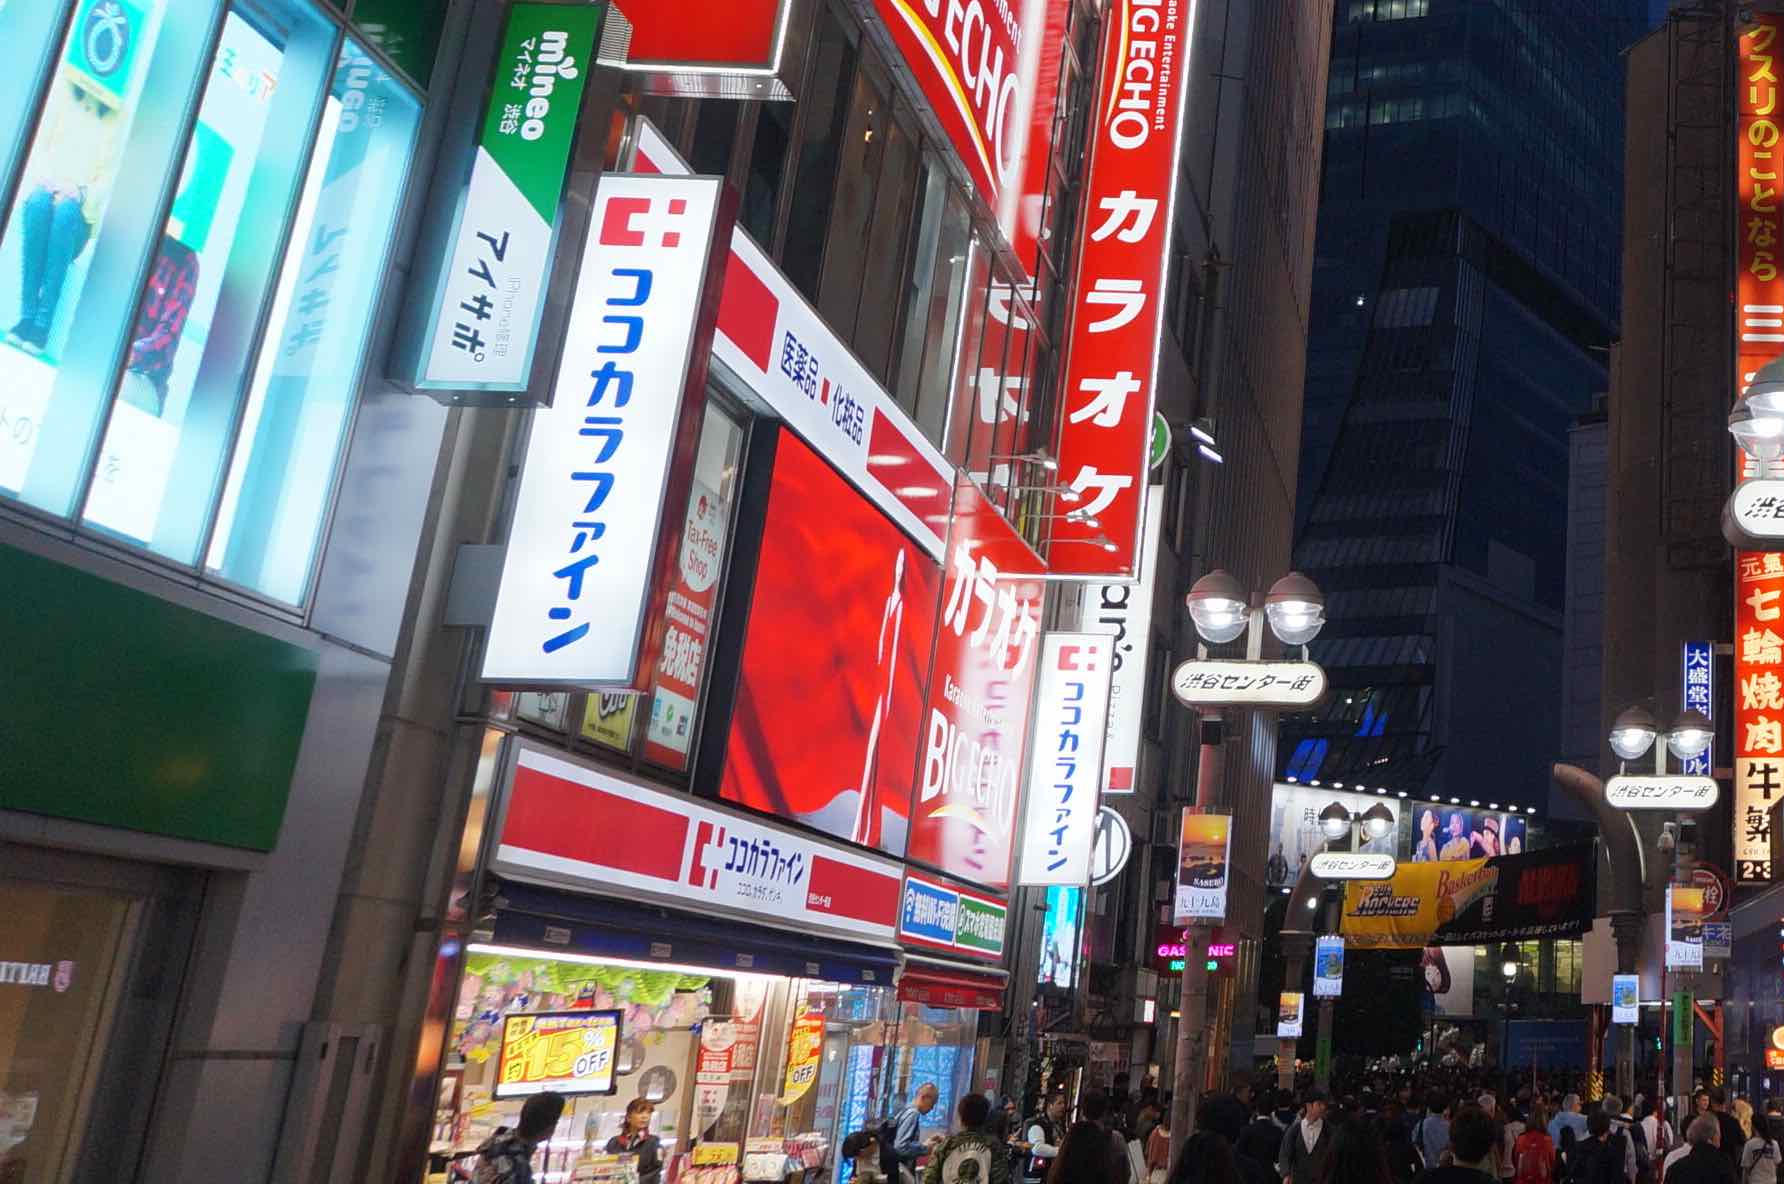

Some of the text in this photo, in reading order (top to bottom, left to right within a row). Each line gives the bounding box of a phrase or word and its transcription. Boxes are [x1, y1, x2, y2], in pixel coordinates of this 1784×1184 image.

[510, 36, 537, 91] マイネオ
[521, 31, 579, 141] mineo
[1110, 41, 1156, 150] ECHO
[1745, 24, 1781, 282] クスリのことなら
[780, 329, 865, 447] 医薬品 化粧品
[1062, 189, 1158, 524] カラオケ
[541, 268, 654, 654] ココカラファイン
[944, 538, 1038, 682] カラオケ
[1179, 672, 1316, 692] 渋谷センター街
[1046, 681, 1084, 872] ココカラファイン
[1611, 784, 1713, 799] 渋谷センター街
[724, 835, 804, 886] ココカラファイン
[575, 1050, 608, 1075] OFF
